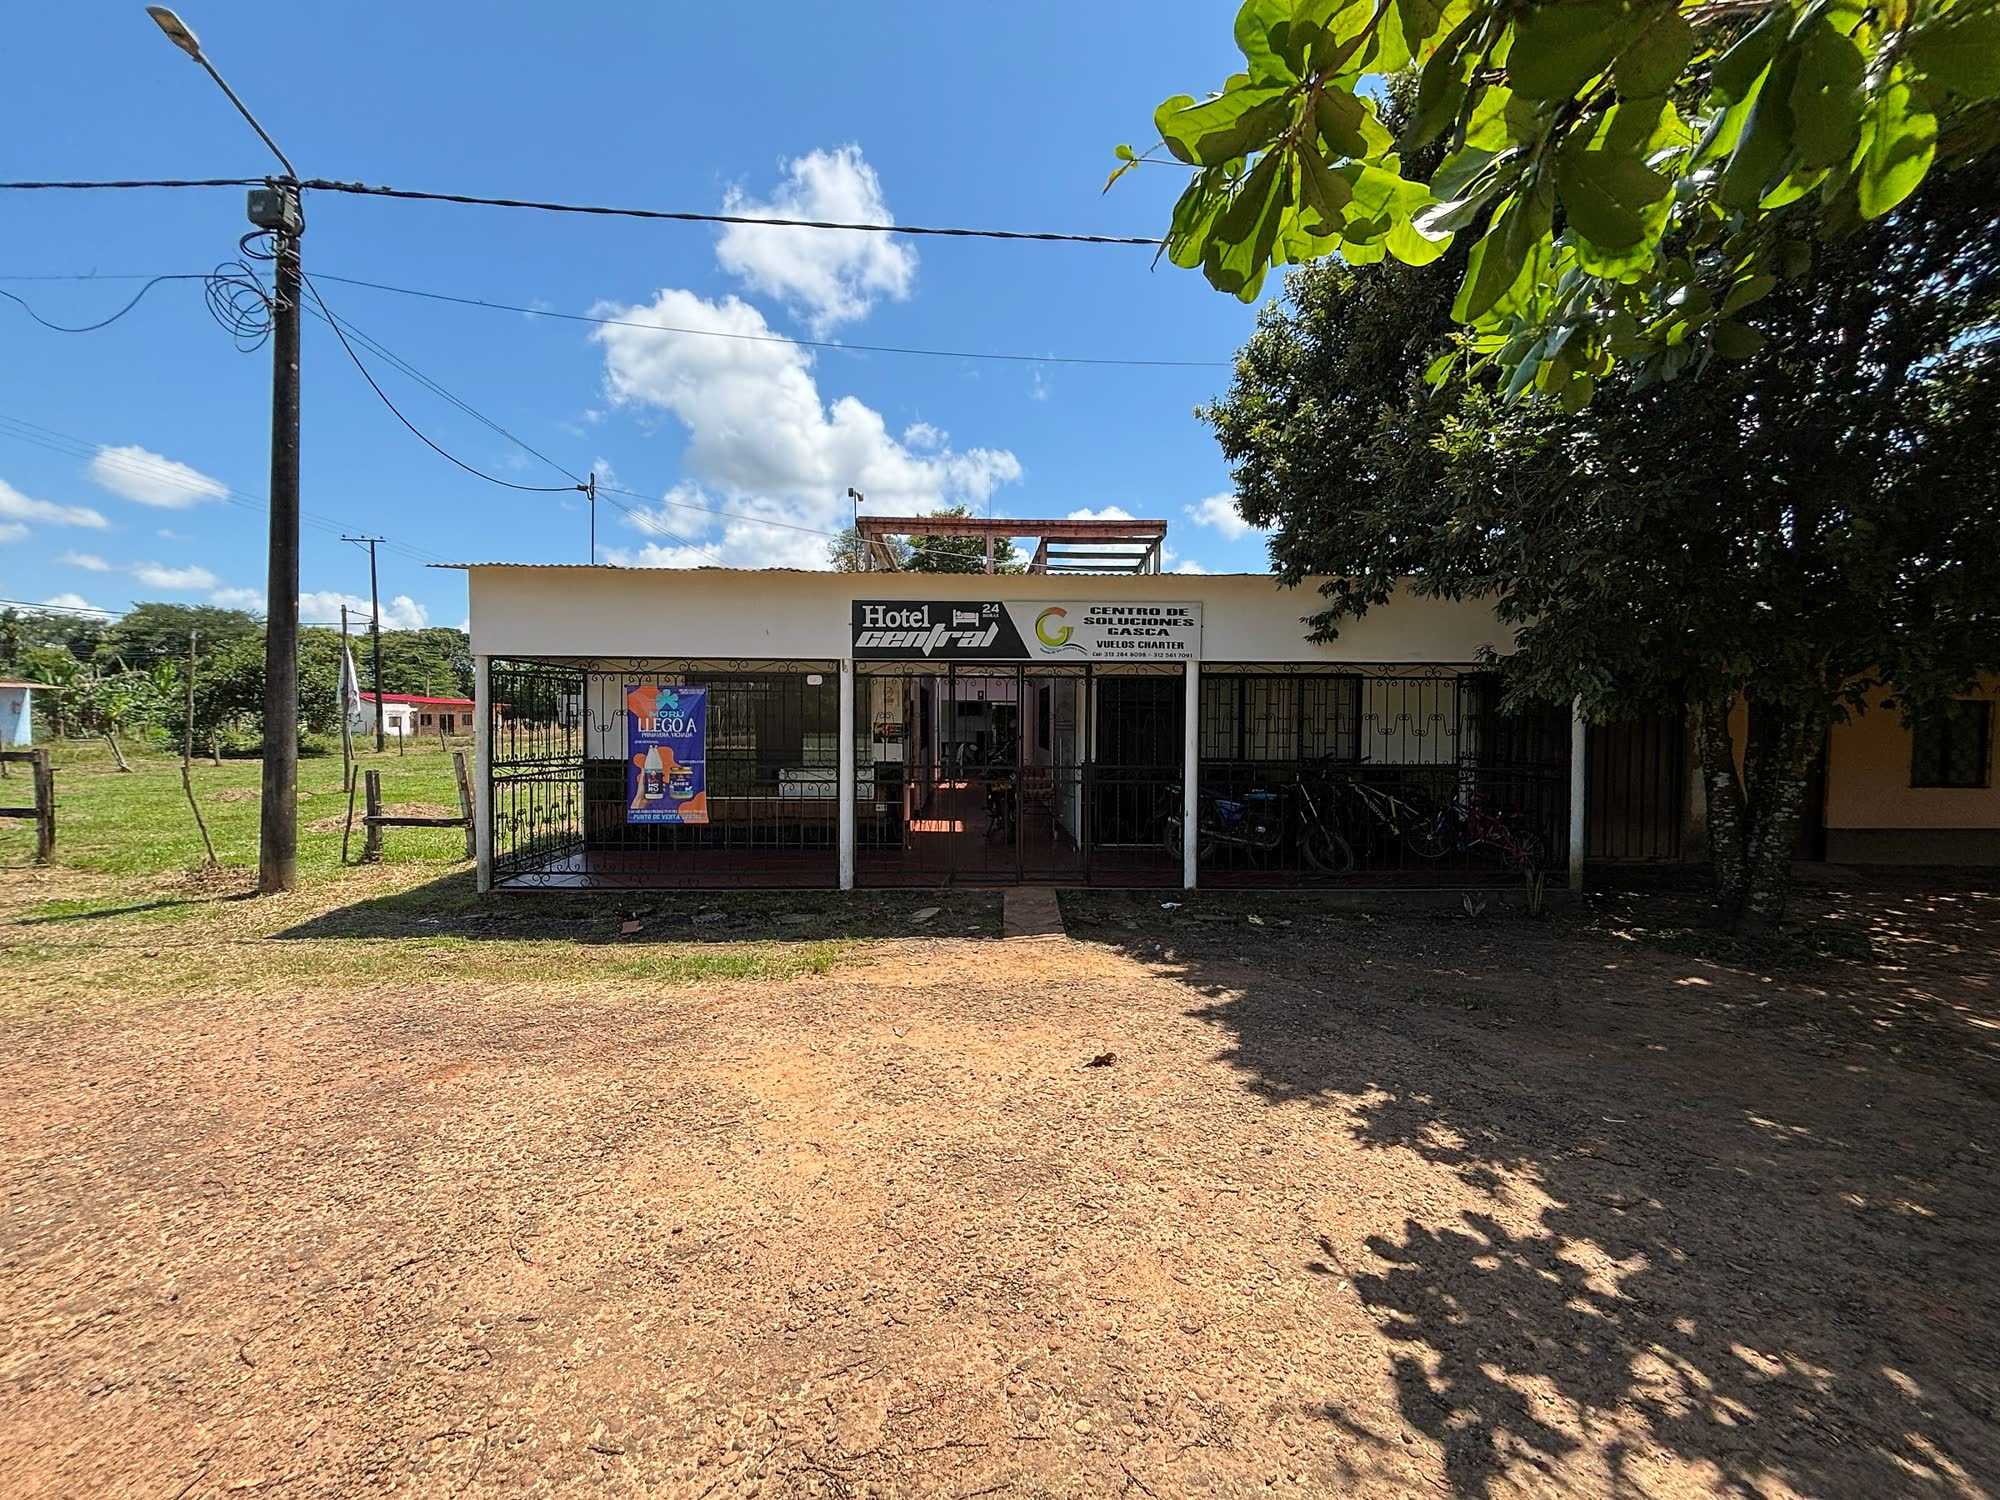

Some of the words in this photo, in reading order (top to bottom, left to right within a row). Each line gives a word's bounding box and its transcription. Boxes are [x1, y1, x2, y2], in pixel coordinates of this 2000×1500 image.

[982, 603, 1000, 614] 24
[1089, 607, 1161, 616] CENTRO
[1166, 608, 1189, 616] DE
[862, 605, 930, 627] Hotel
[1083, 617, 1195, 626] SOLUCIONES
[1107, 627, 1170, 637] GASCA
[1096, 640, 1135, 649] VUELOS
[1137, 641, 1185, 650] CHARTER
[638, 717, 683, 733] LLEGO
[686, 718, 697, 733] A
